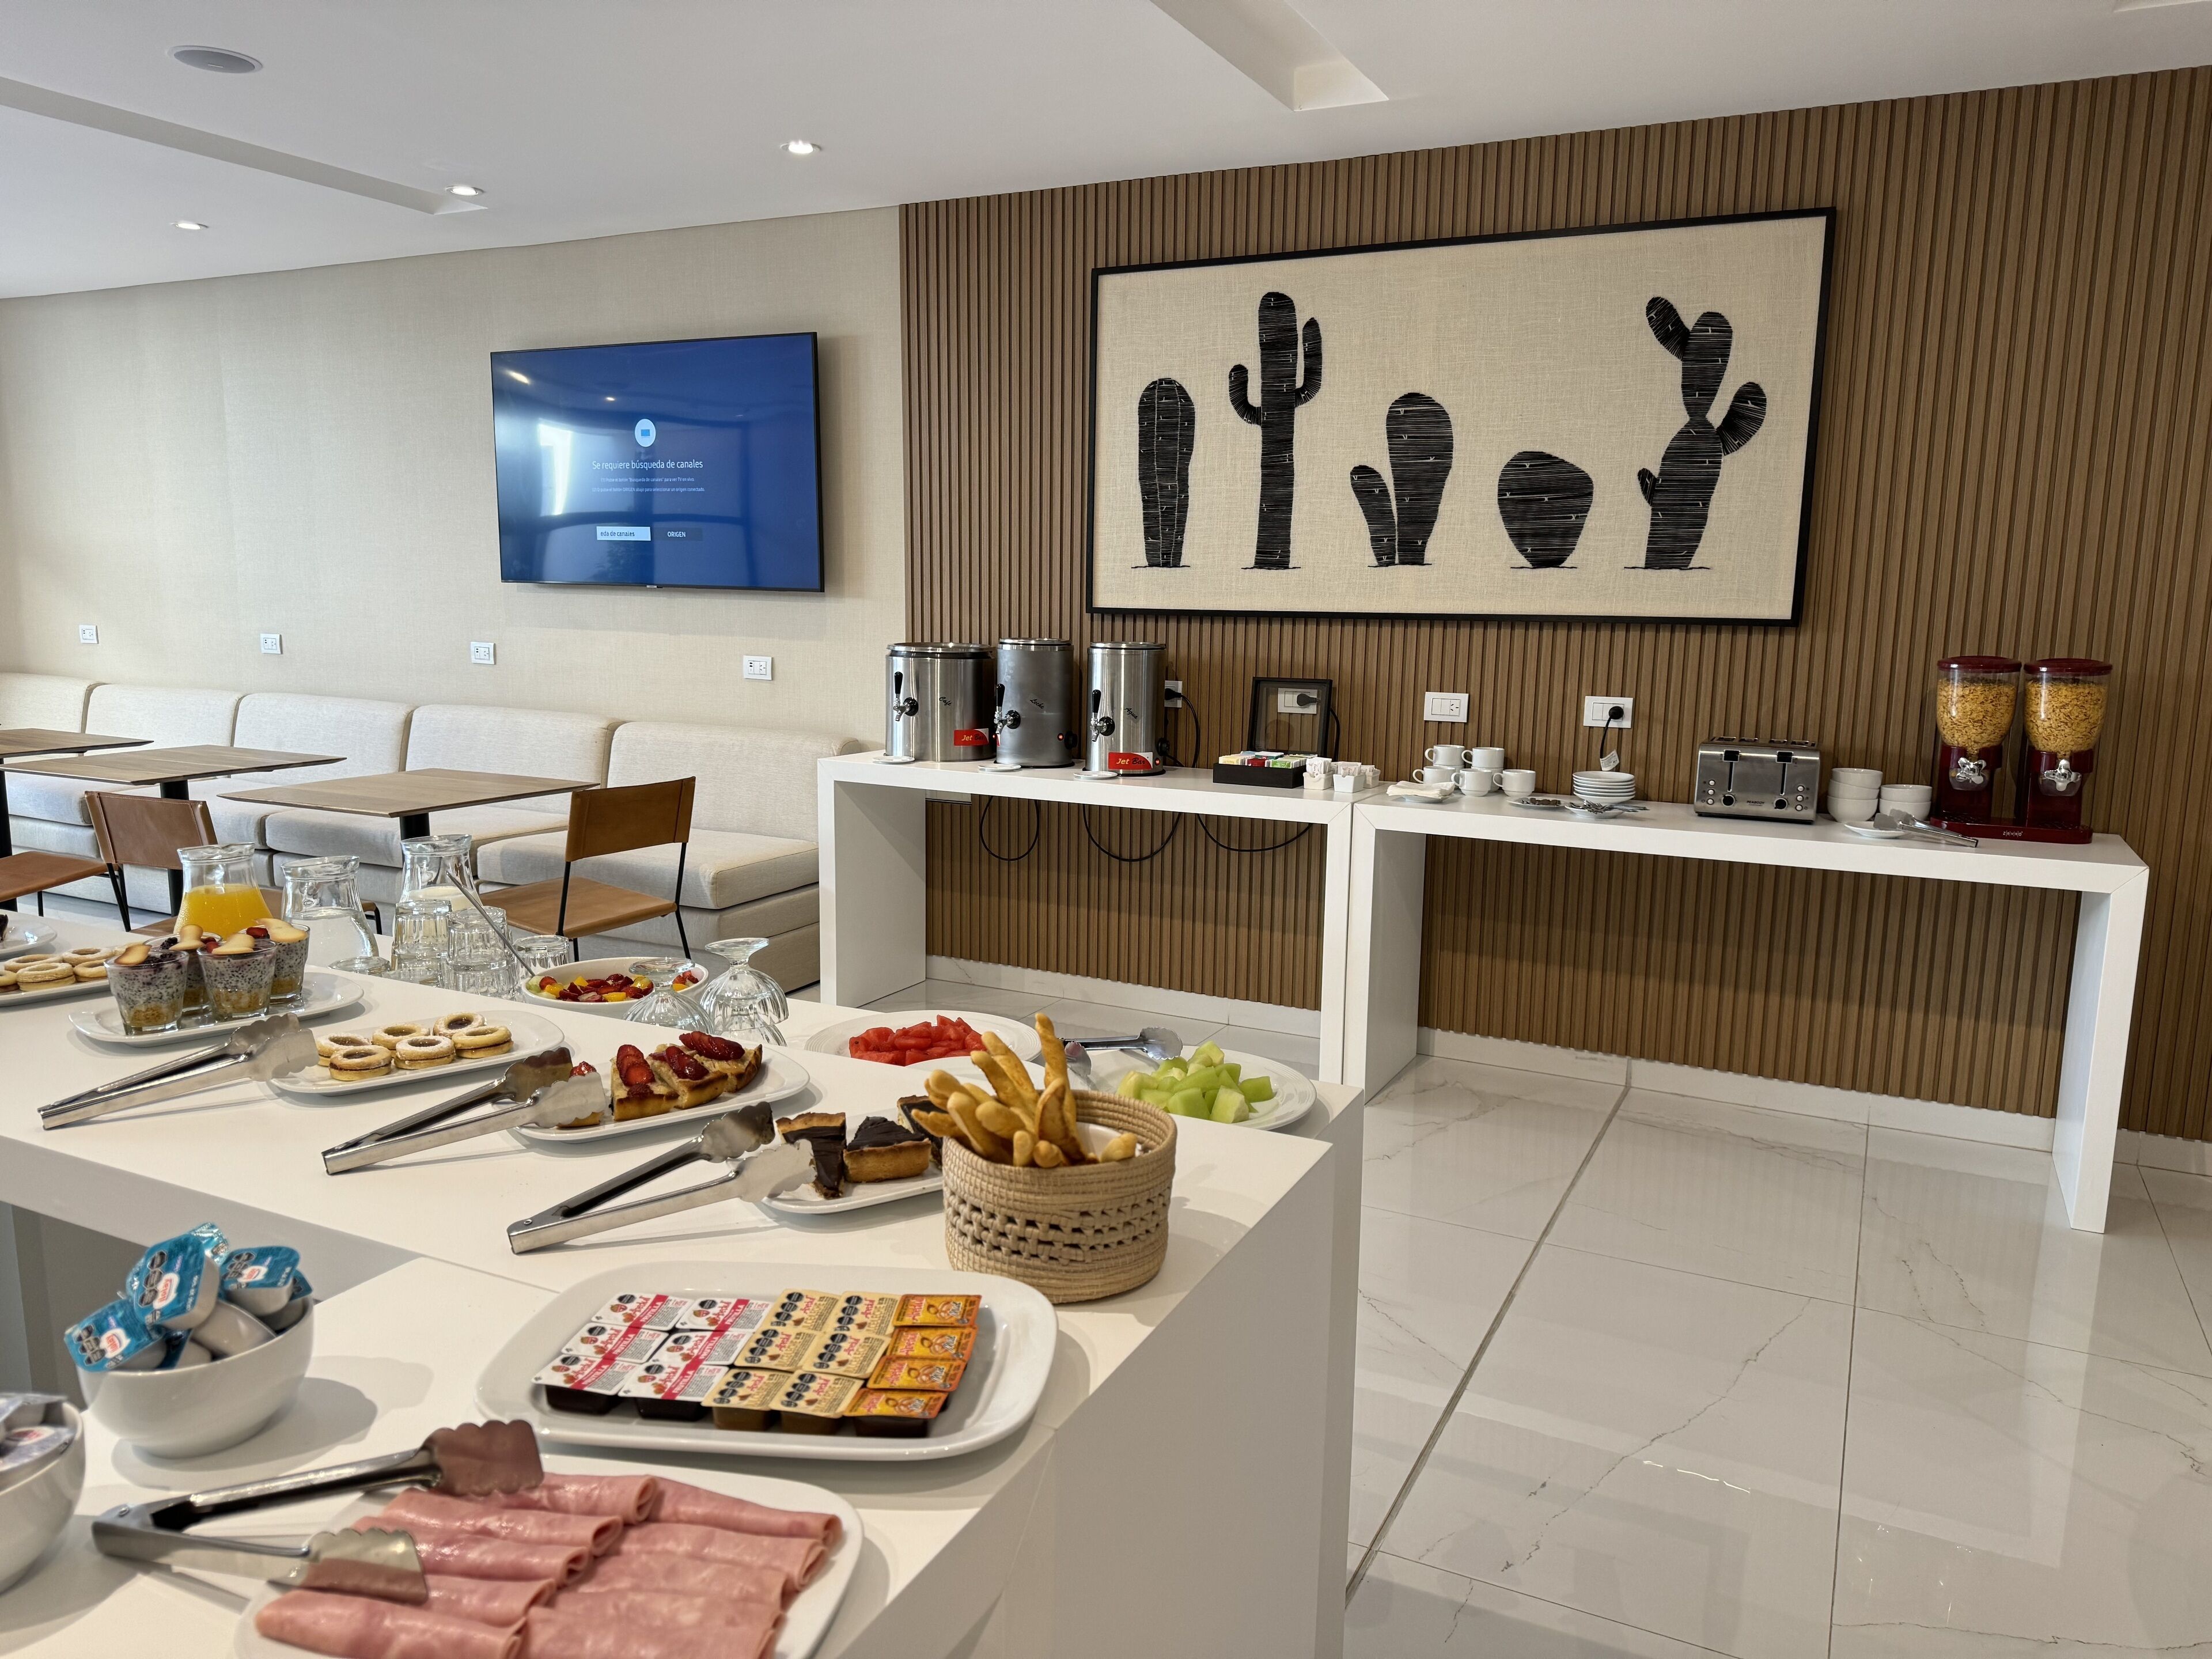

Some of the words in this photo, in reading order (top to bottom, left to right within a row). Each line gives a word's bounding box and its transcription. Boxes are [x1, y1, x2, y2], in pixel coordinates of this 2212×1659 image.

[592, 461, 600, 469] Se
[602, 460, 630, 471] requiere
[631, 460, 665, 470] búsqueda
[666, 459, 675, 468] de
[677, 459, 703, 468] canales
[1029, 699, 1044, 709] Leche
[1124, 707, 1138, 719] Agua
[1131, 757, 1145, 765] Bar
[640, 1301, 663, 1322] FRUTILLA
